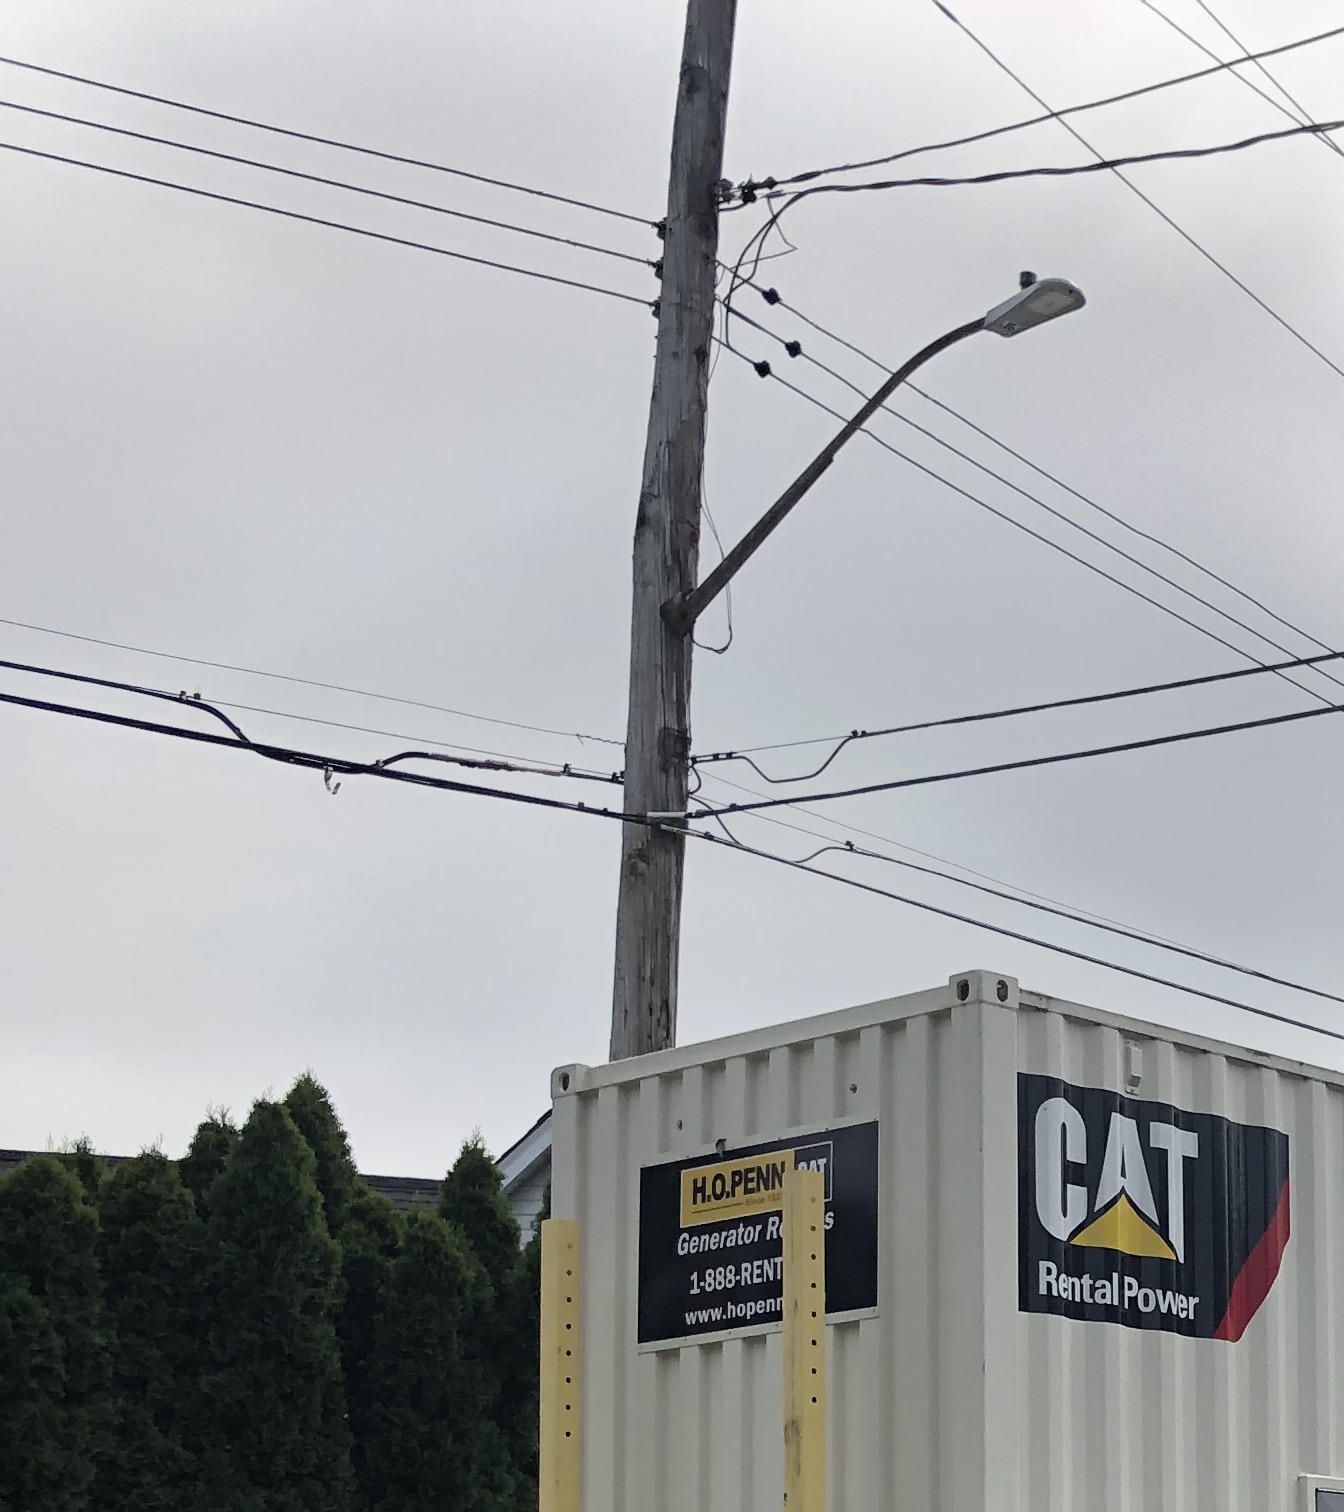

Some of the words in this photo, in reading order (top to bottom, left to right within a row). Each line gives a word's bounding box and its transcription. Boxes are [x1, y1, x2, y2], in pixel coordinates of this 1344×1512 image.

[692, 1161, 785, 1205] H.O.PENN
[1035, 1097, 1199, 1264] CAT
[677, 1222, 763, 1256] Generator
[690, 1257, 783, 1294] 1-888-RENT
[1038, 1261, 1119, 1306] Rental
[1123, 1275, 1200, 1320] Power
